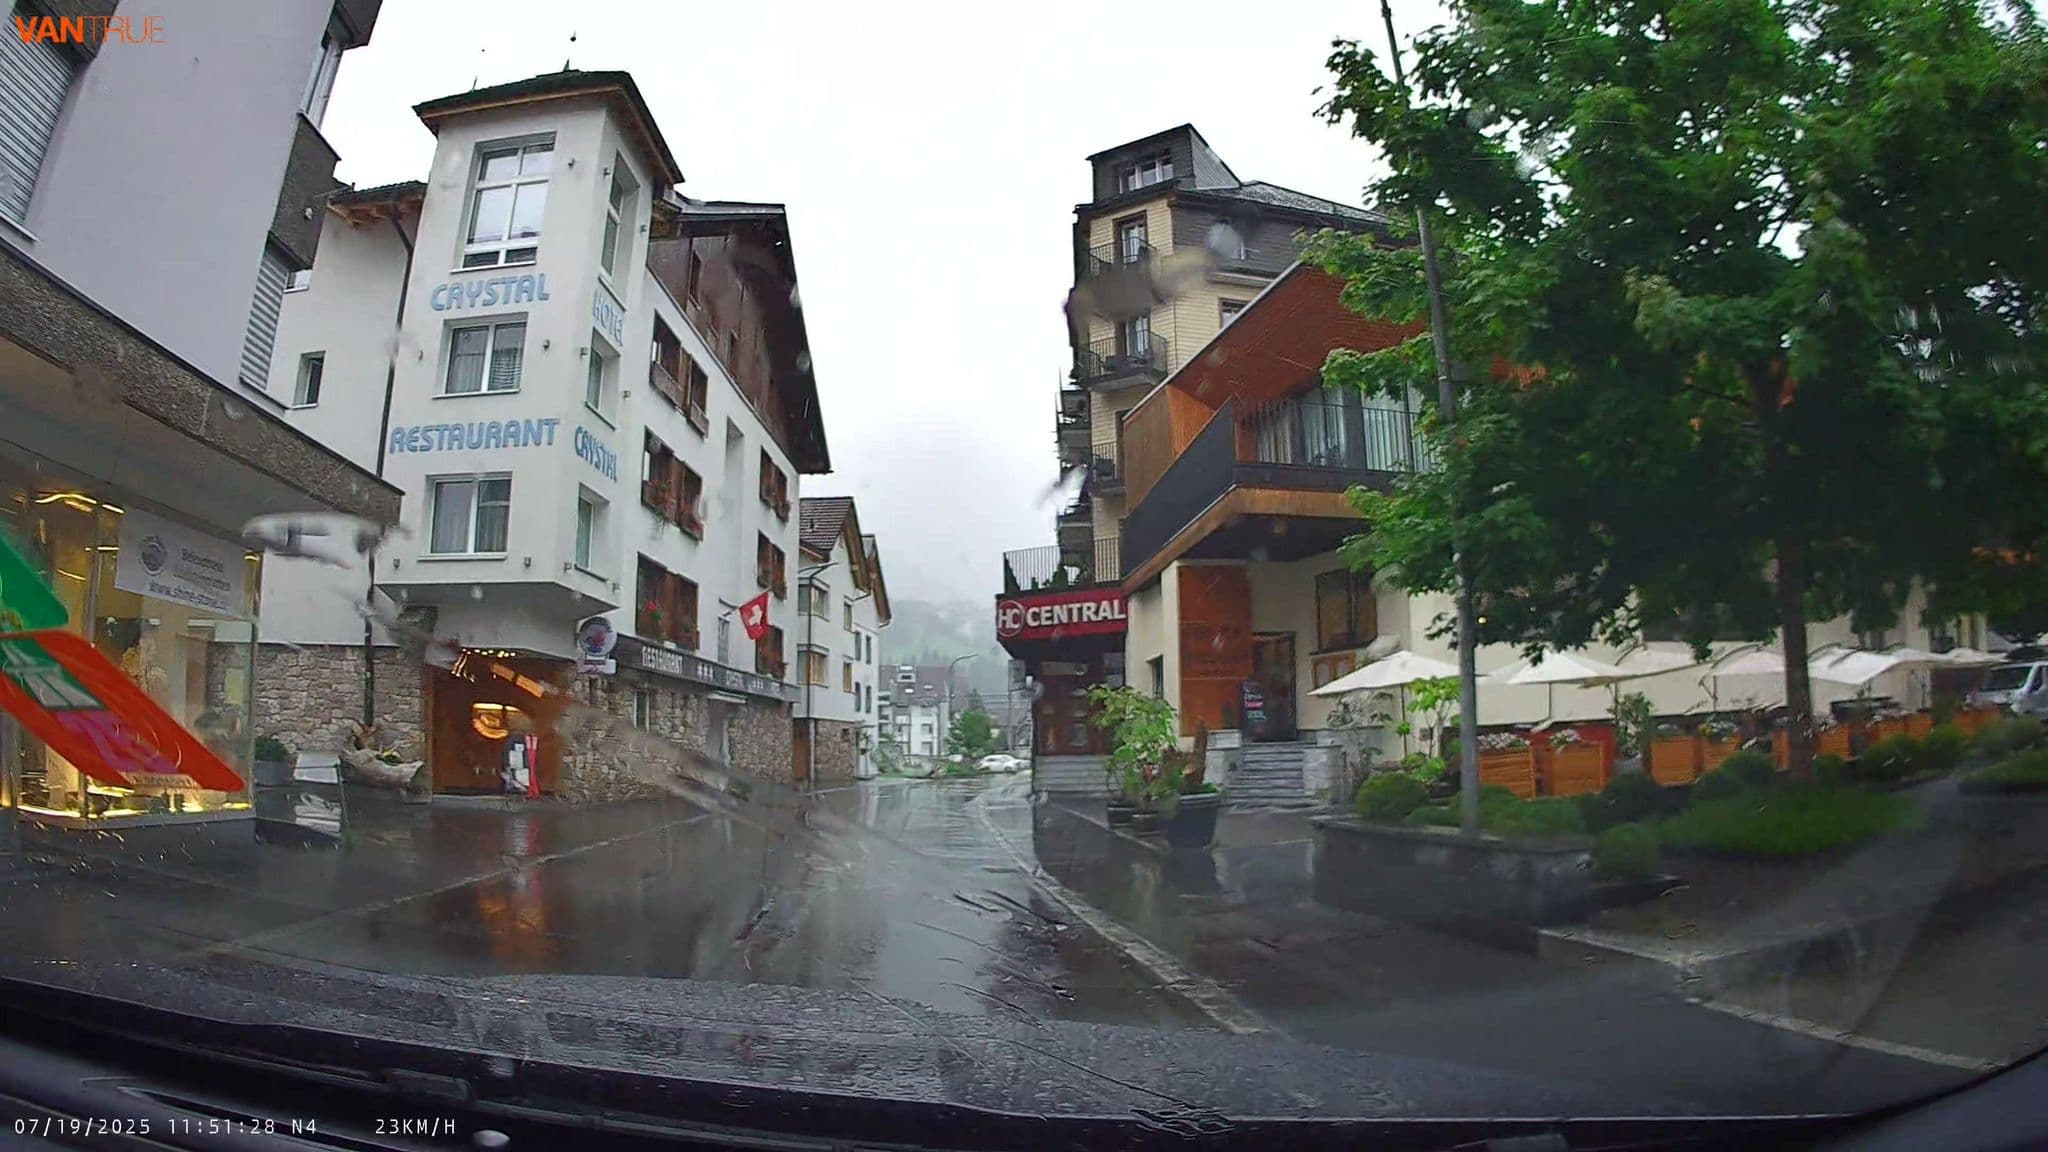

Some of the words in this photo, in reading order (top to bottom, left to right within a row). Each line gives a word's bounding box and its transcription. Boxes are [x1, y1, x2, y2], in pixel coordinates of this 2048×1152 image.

[430, 273, 551, 312] CRYSTAL
[592, 289, 625, 347] HOTEL
[389, 418, 560, 454] RESTAURANT
[574, 426, 618, 483] CRYSTAL
[998, 607, 1021, 629] HC
[1026, 599, 1126, 627] CENTRAL
